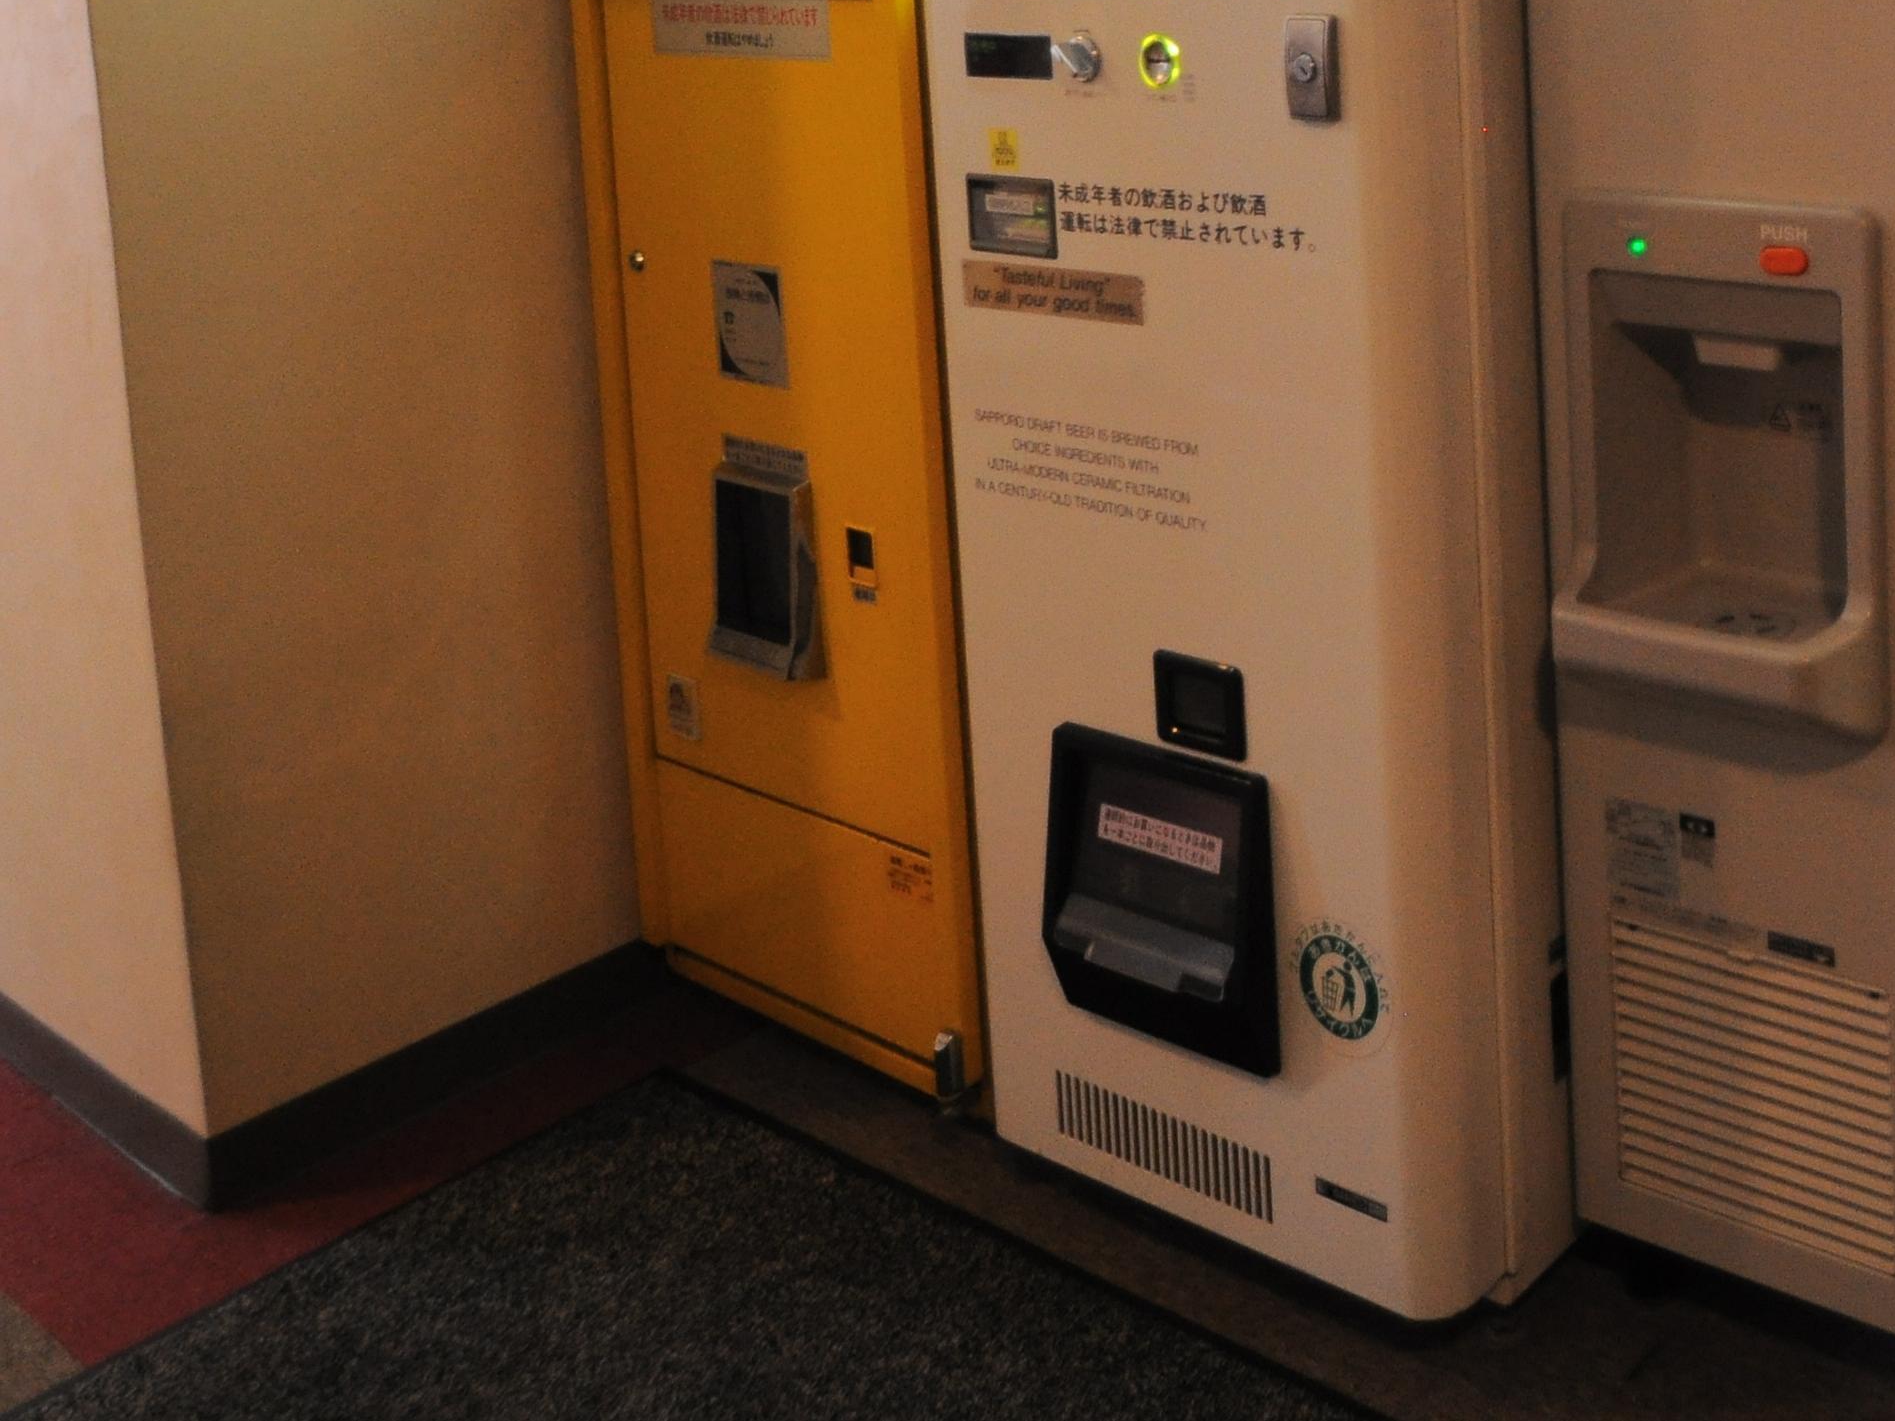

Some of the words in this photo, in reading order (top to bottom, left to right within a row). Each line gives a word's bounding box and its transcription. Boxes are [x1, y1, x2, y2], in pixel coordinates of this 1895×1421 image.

[1058, 182, 1267, 217] 未成年者の飲酒および飲酒
[1058, 211, 1317, 253] 運転は法律で禁止されています。
[1760, 224, 1809, 244] PUSH
[973, 286, 990, 303] for
[994, 288, 1011, 304] all
[1016, 293, 1048, 309] your
[1053, 295, 1090, 314] good
[975, 408, 1025, 429] SAPPORO
[1027, 416, 1062, 434] DRAFT
[1065, 422, 1096, 440] BEER
[1098, 426, 1109, 441] IS
[1111, 428, 1161, 452] BREWED
[1163, 438, 1200, 457] FROM
[1012, 437, 1051, 457] CHOICE
[1055, 444, 1126, 470] INGREDIENTS
[1128, 457, 1160, 475] WITH
[987, 457, 1070, 483] ULTRA-MODERN
[1073, 471, 1122, 494] CERAMIC
[1125, 480, 1191, 505] FILTRATION
[975, 478, 987, 493] IN
[1075, 496, 1134, 520] TRADITION
[1138, 507, 1154, 522] OF
[1155, 511, 1207, 532] QUALITY
